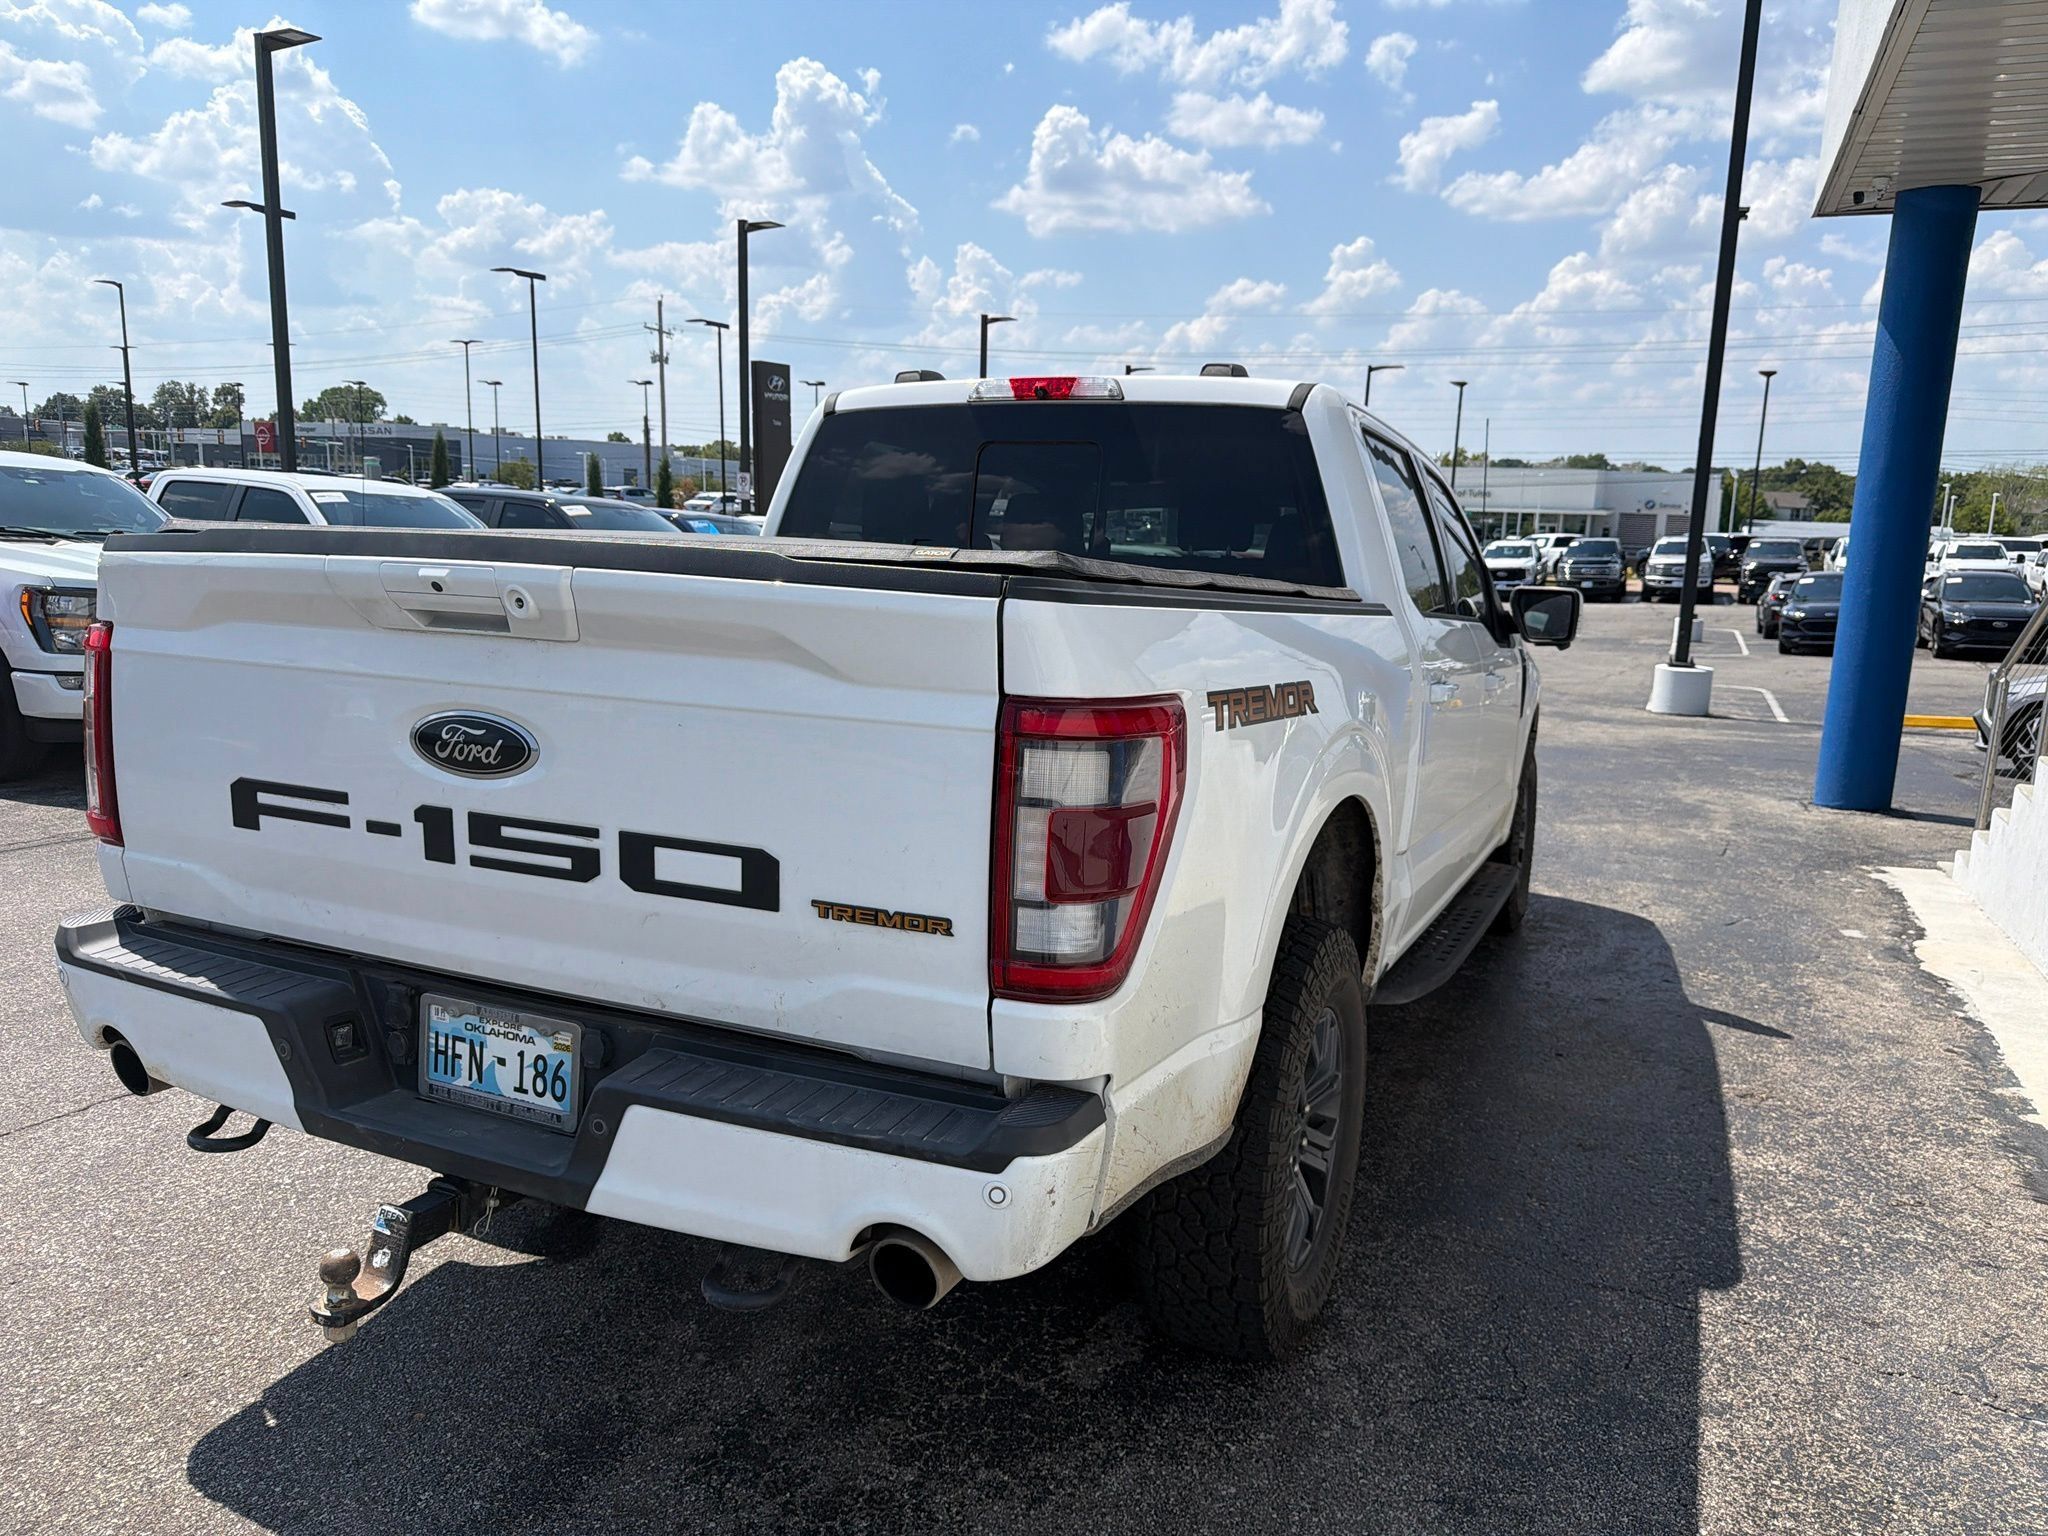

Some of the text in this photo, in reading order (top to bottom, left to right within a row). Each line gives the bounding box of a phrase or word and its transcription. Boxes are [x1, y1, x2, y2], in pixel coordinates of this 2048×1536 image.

[347, 426, 393, 436] NISSAN
[1207, 680, 1319, 732] TREMOR
[435, 723, 503, 766] Ford
[230, 777, 781, 912] F-150
[811, 899, 954, 937] TREMOR
[464, 1022, 536, 1047] OKLAHOMA
[478, 1016, 523, 1032] EXPLORE
